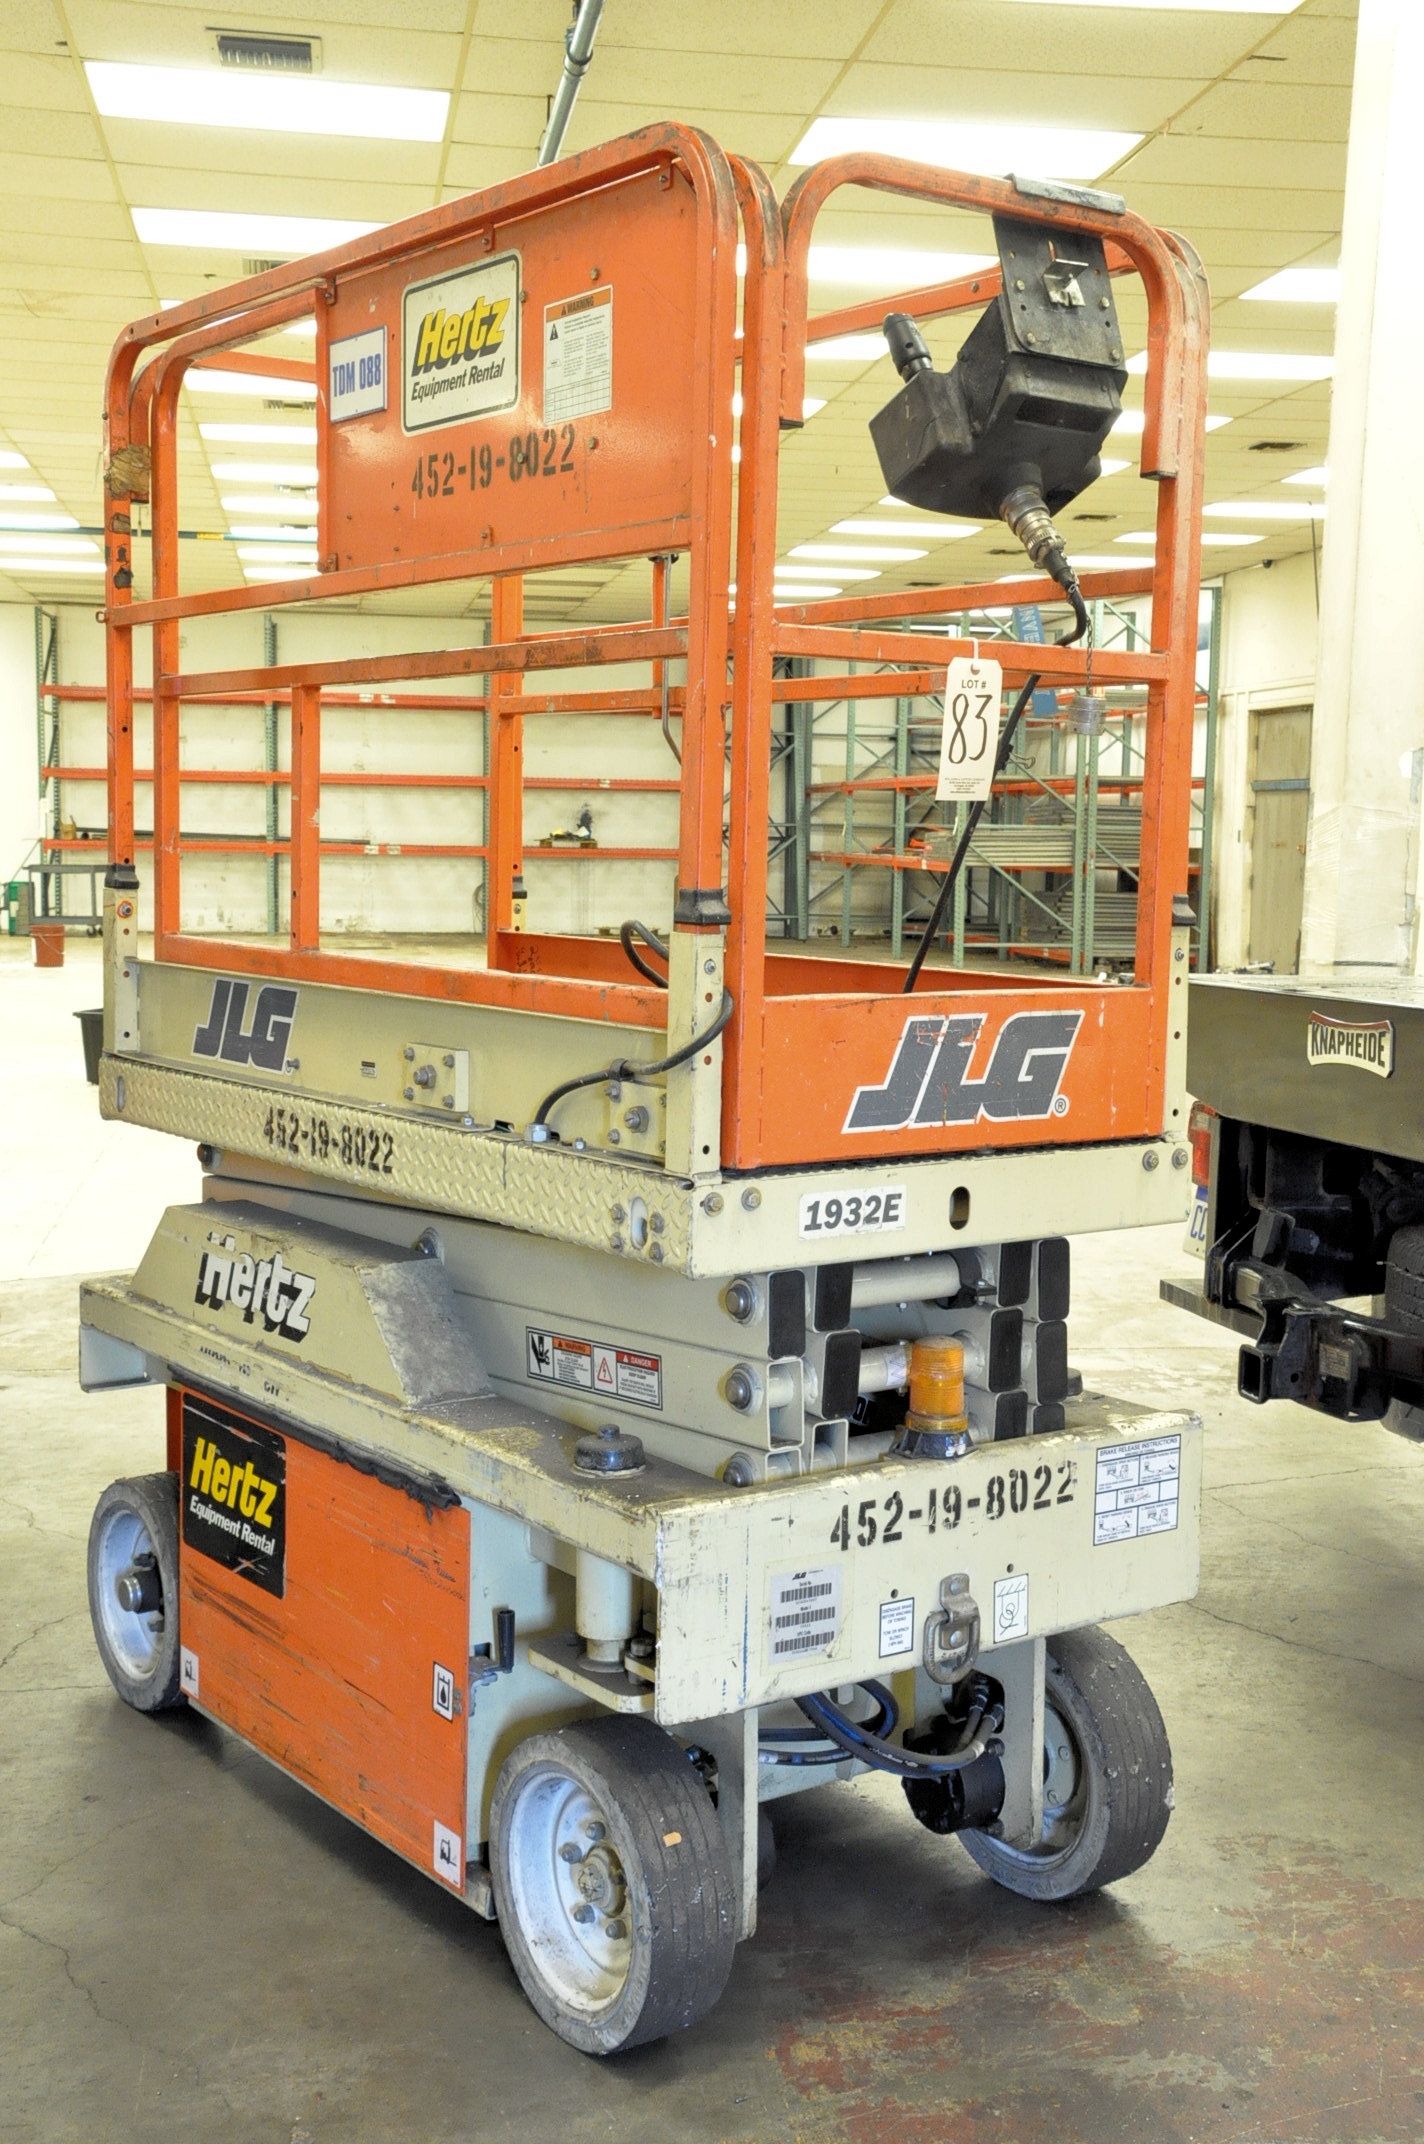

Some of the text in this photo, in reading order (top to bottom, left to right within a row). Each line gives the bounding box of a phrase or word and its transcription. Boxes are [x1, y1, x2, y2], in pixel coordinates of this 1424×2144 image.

[411, 296, 511, 376] Hertz
[332, 353, 382, 398] TDM 088
[411, 358, 506, 403] Equipment Rental
[411, 424, 575, 500] 452-19-8022
[961, 679, 979, 689] LOT
[948, 693, 993, 765] 83
[191, 977, 299, 1075] JLG
[1310, 1021, 1386, 1068] KNAPHEIDE
[264, 1105, 394, 1173] 452-19-8022
[803, 1192, 902, 1231] 1932E
[1100, 1449, 1117, 1457] BRAKE
[1118, 1444, 1140, 1452] RELEASE
[1142, 1437, 1178, 1449] INSTRUCTIONS
[189, 1437, 278, 1529] Hertz
[830, 1460, 1078, 1551] 452-19-8022
[189, 1495, 275, 1556] Equipment Rental
